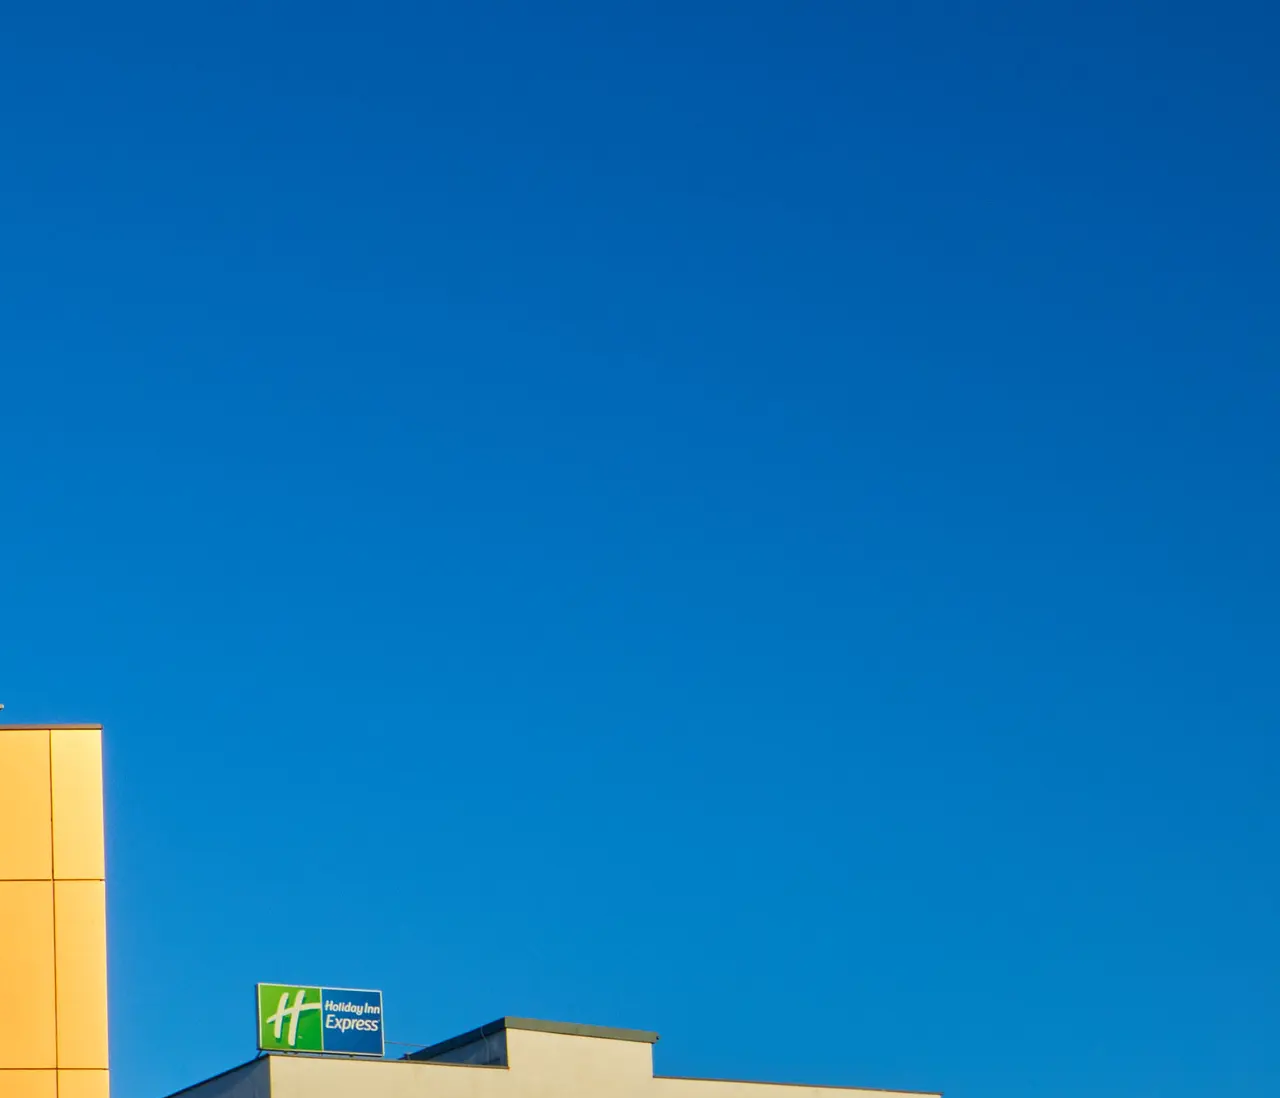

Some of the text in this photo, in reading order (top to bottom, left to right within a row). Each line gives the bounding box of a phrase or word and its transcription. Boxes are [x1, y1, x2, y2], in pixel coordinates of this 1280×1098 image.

[325, 1000, 380, 1015] Holiday Inn
[325, 1014, 379, 1033] Express
